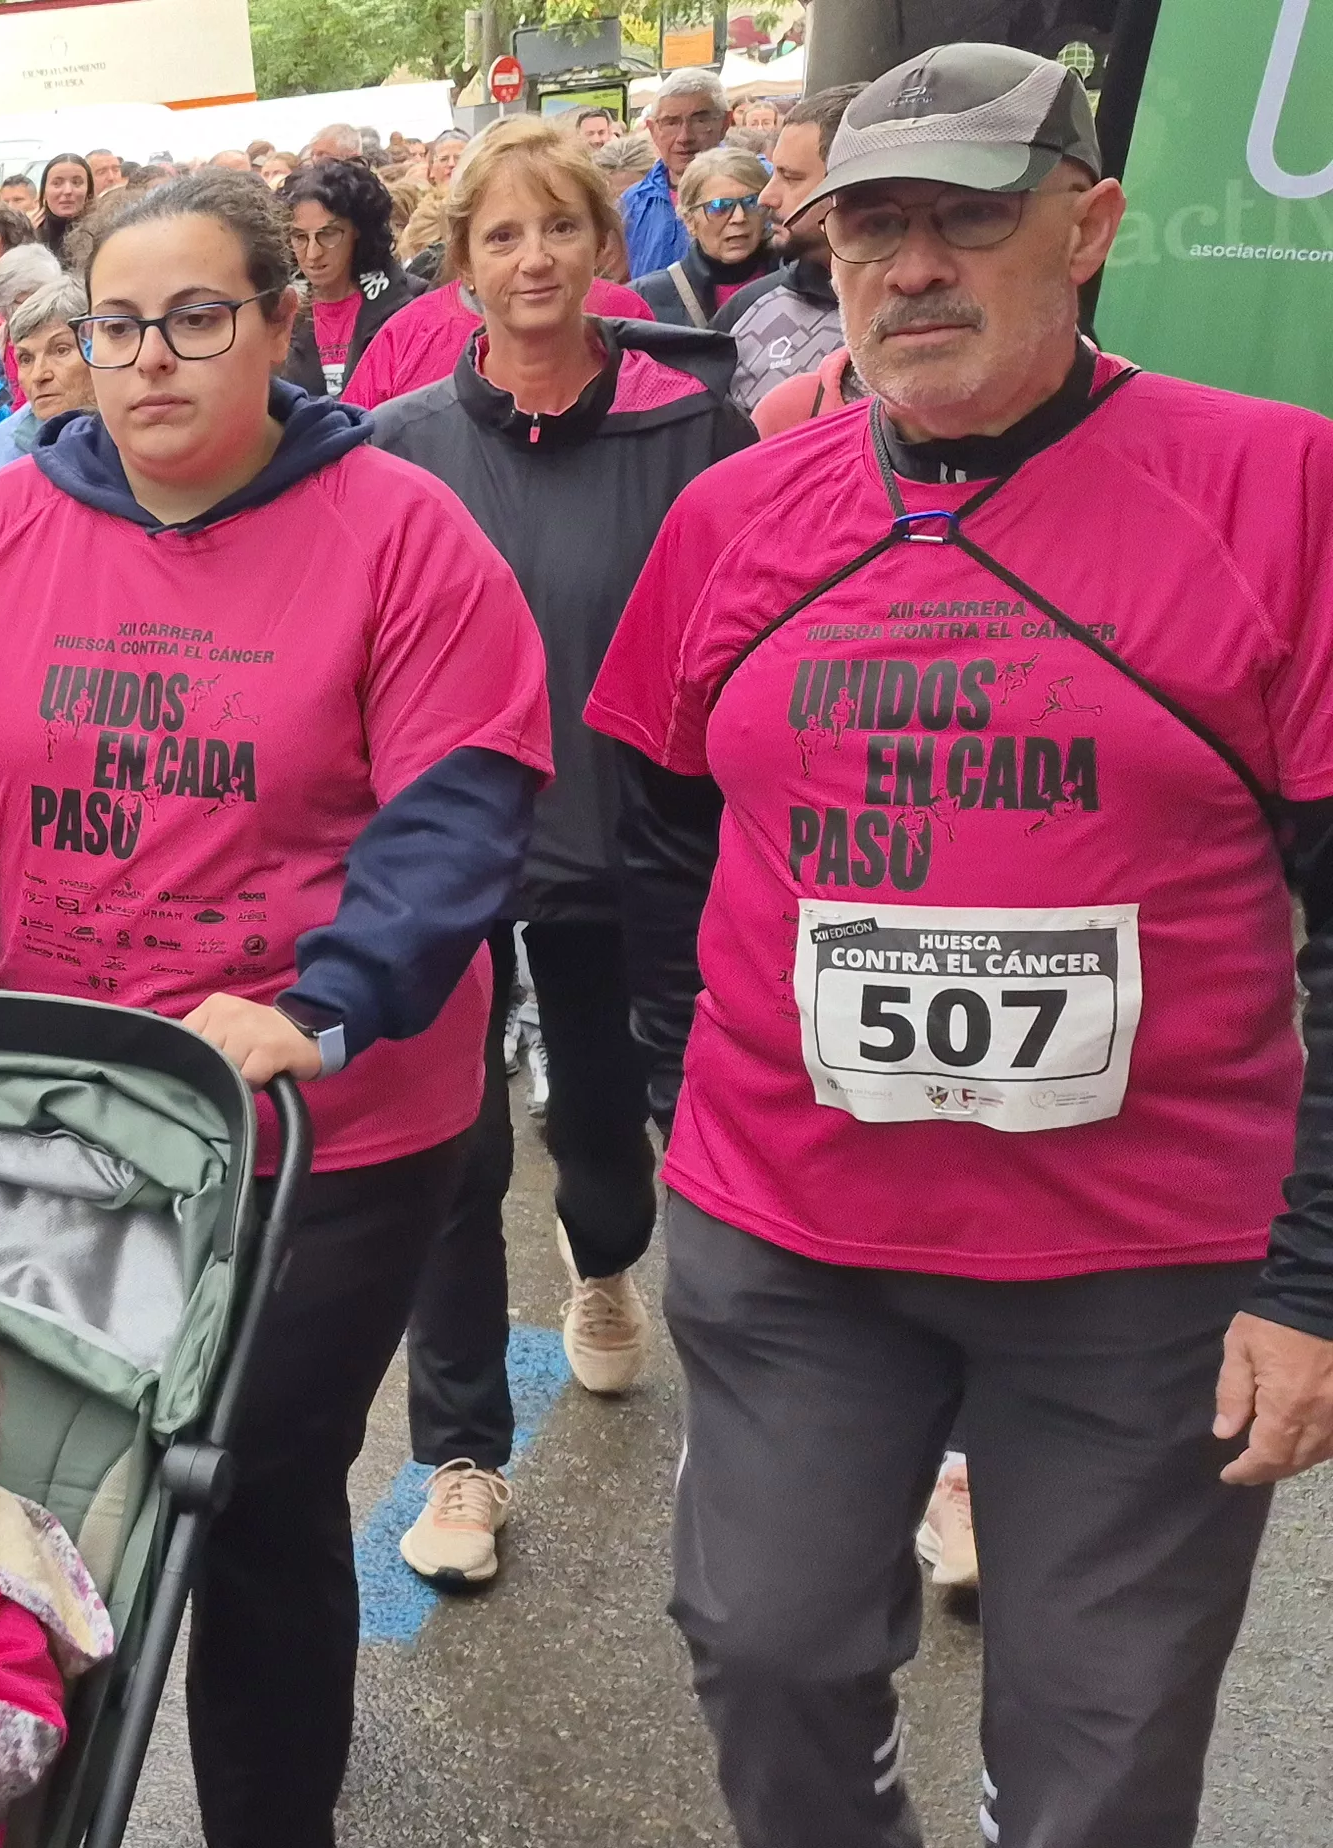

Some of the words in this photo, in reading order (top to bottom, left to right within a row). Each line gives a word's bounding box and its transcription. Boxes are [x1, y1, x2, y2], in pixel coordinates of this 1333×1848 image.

[116, 623, 137, 636] XII
[139, 623, 215, 643] CARRERA
[807, 624, 883, 641] HUESCA
[889, 622, 980, 640] CONTRA
[987, 623, 1013, 640] EL
[1021, 619, 1117, 642] CÁNER
[920, 600, 1028, 618] CARRERA
[54, 635, 116, 653] HUESCA
[121, 640, 179, 656] CONTRA
[184, 646, 203, 660] EL
[208, 647, 275, 664] CÁNCER
[38, 664, 190, 732] UNIDOS
[788, 657, 998, 732] UNIDOS
[93, 730, 149, 792] EN
[154, 735, 257, 803] CADA
[865, 736, 936, 806] EN
[947, 735, 1101, 812] CADA
[31, 784, 143, 860] PASO
[789, 805, 932, 892] PASO
[831, 947, 939, 974] CONTRA
[946, 953, 978, 974] EL
[985, 949, 1101, 975] CÁNCER
[919, 934, 1002, 951] HUESCA
[859, 984, 1068, 1070] 507
